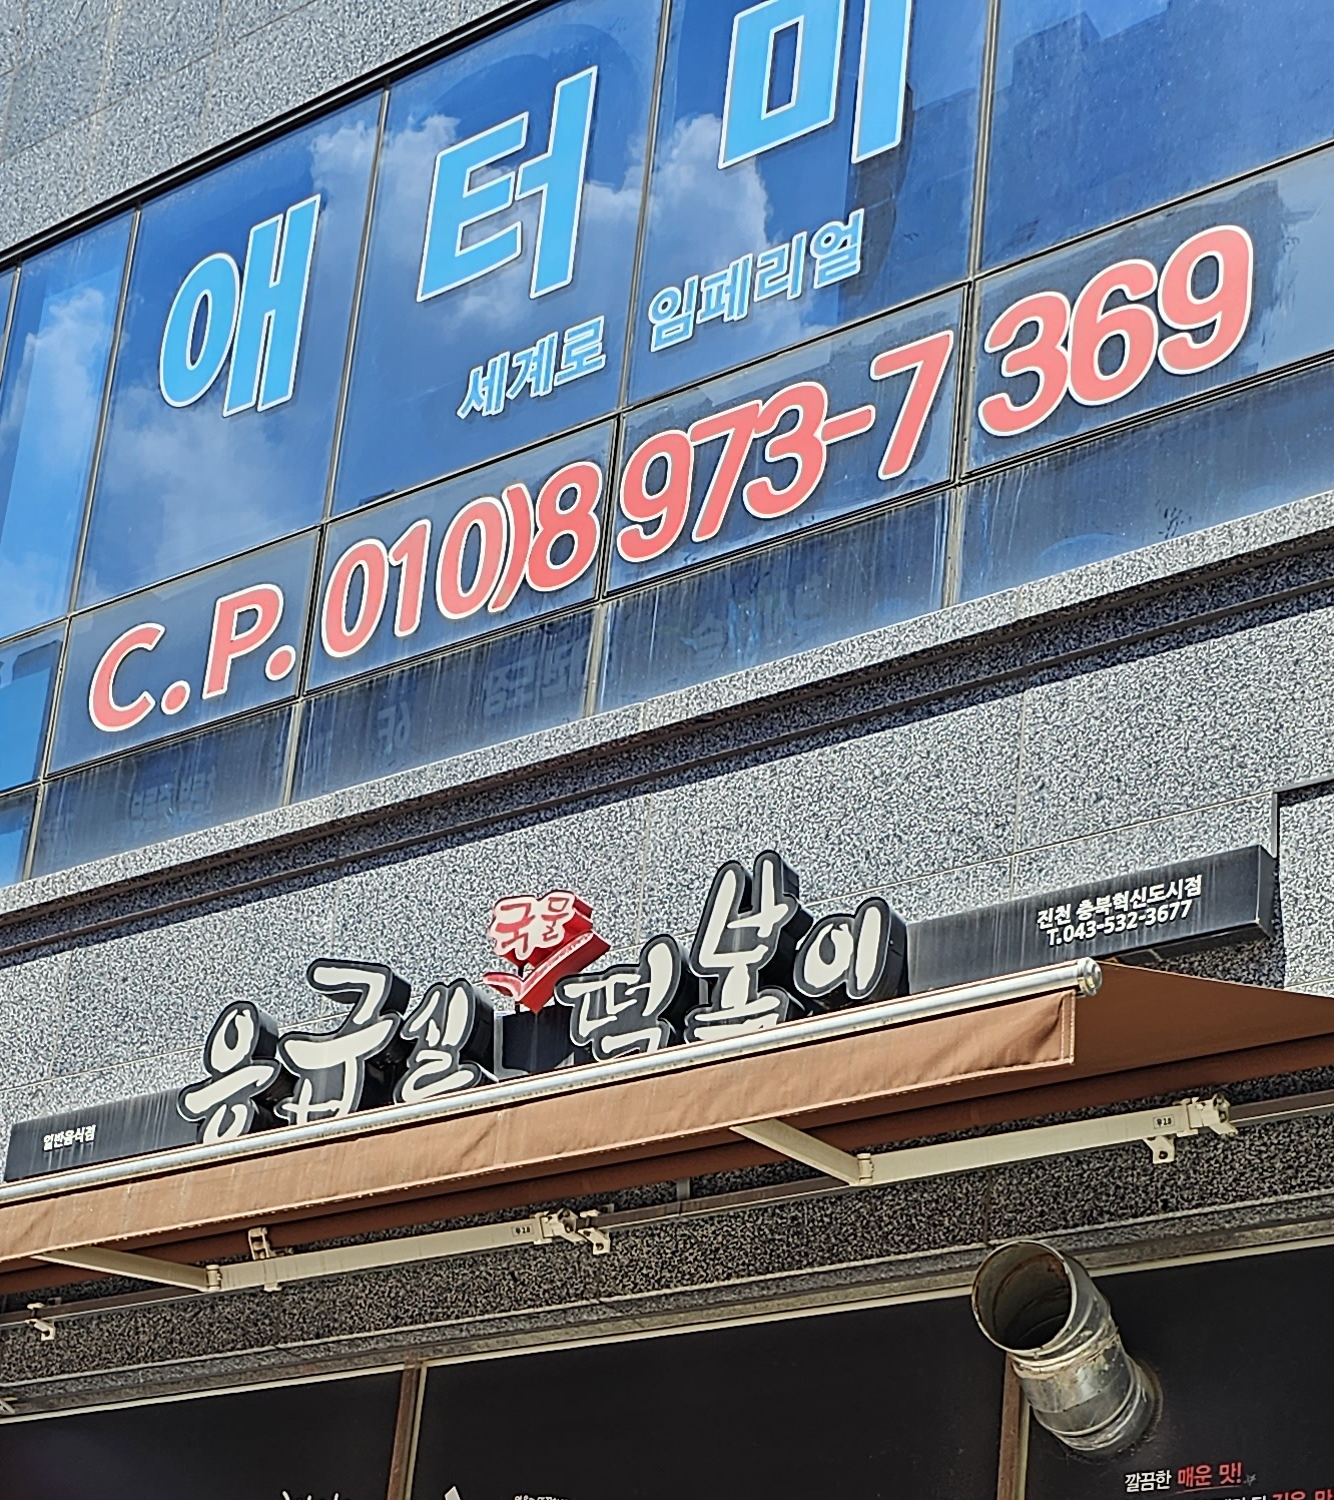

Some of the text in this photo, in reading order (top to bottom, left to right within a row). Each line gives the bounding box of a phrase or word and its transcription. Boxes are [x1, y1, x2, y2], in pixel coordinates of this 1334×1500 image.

[457, 209, 865, 420] 세계로 임페리얼
[87, 583, 297, 735] C.P.
[1037, 874, 1204, 931] 진천 충북혁신도시점
[1047, 899, 1194, 946] T.043-532-3677
[179, 958, 485, 1146] 응급실
[1123, 1462, 1243, 1493] 깔끔한 매운 맛!
